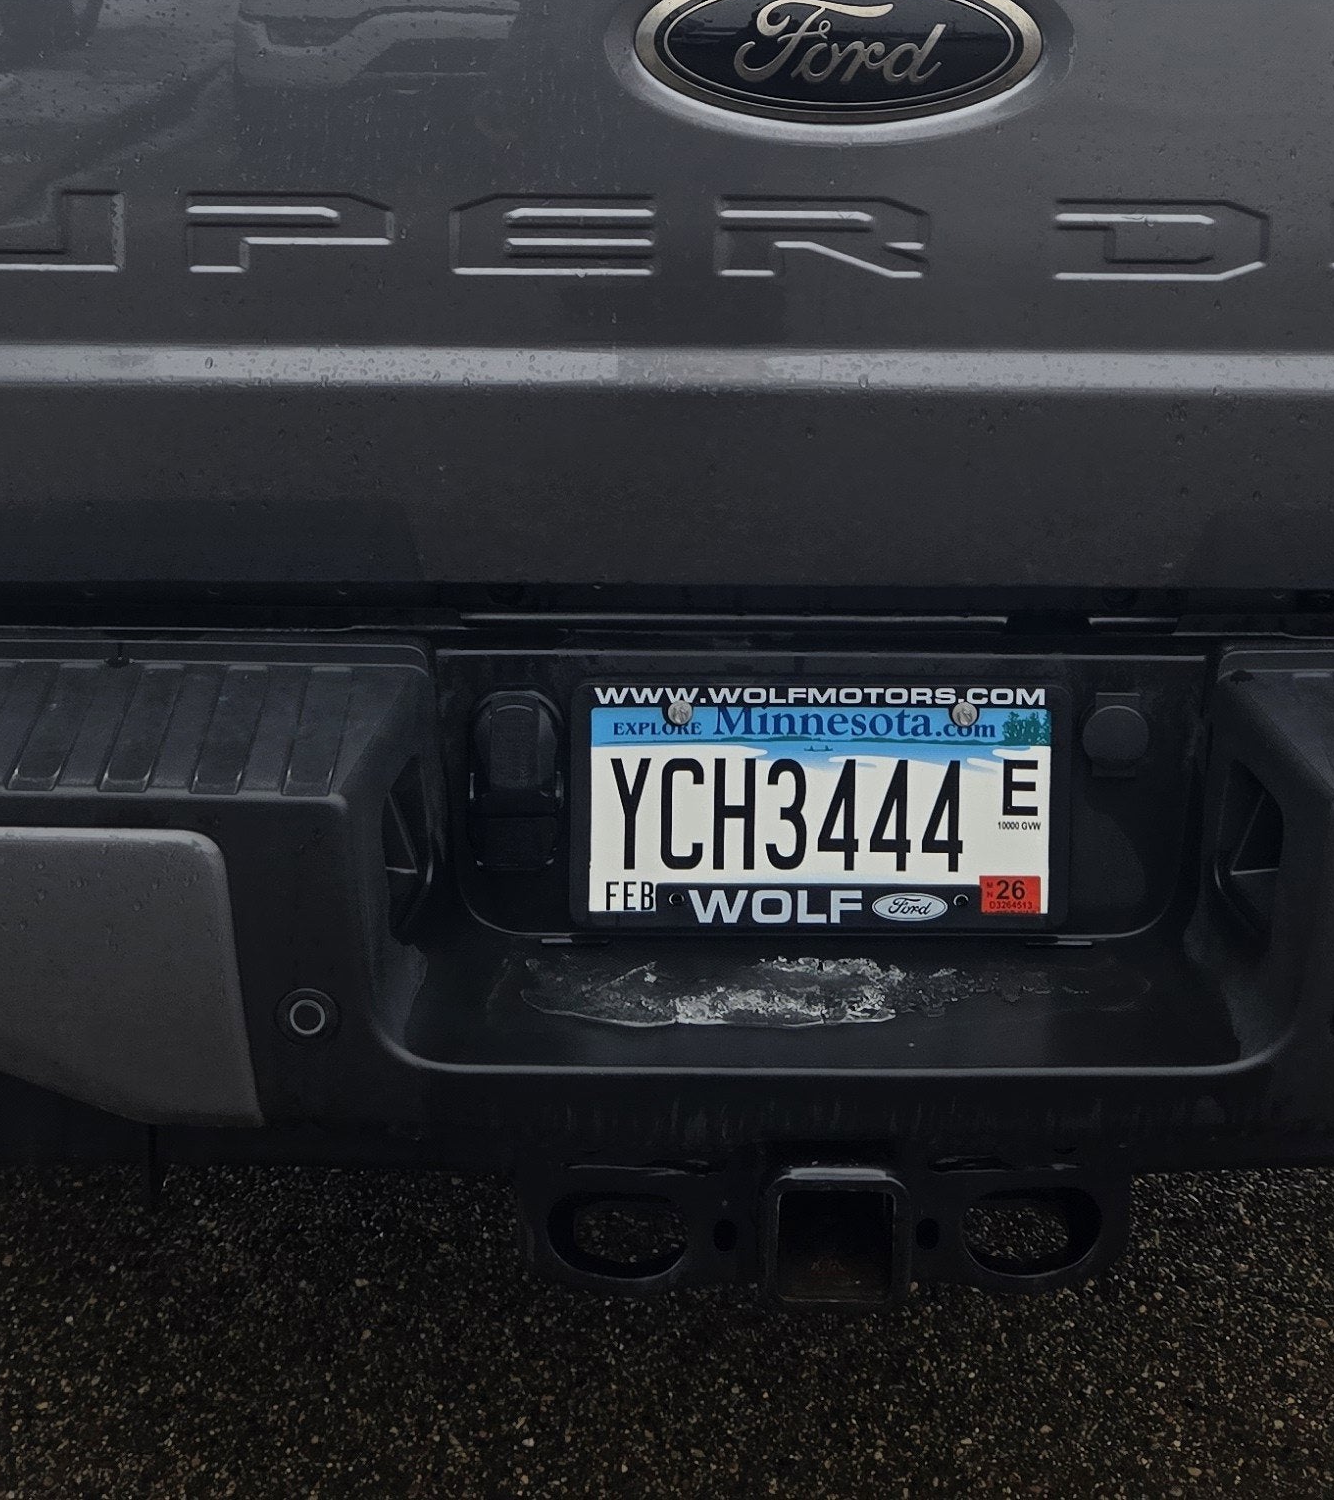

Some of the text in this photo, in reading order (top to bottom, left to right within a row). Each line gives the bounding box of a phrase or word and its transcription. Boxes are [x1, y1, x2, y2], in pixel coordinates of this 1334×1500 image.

[594, 686, 1046, 706] WWW.WOLFMOTORS.COM
[613, 721, 703, 736] EXPLORE
[1002, 758, 1039, 816] E
[610, 757, 964, 872] YCH3444
[997, 821, 1042, 831] 10000 GVW
[605, 880, 655, 911] FEB
[996, 879, 1026, 900] 26
[688, 889, 933, 924] WOLF Ford
